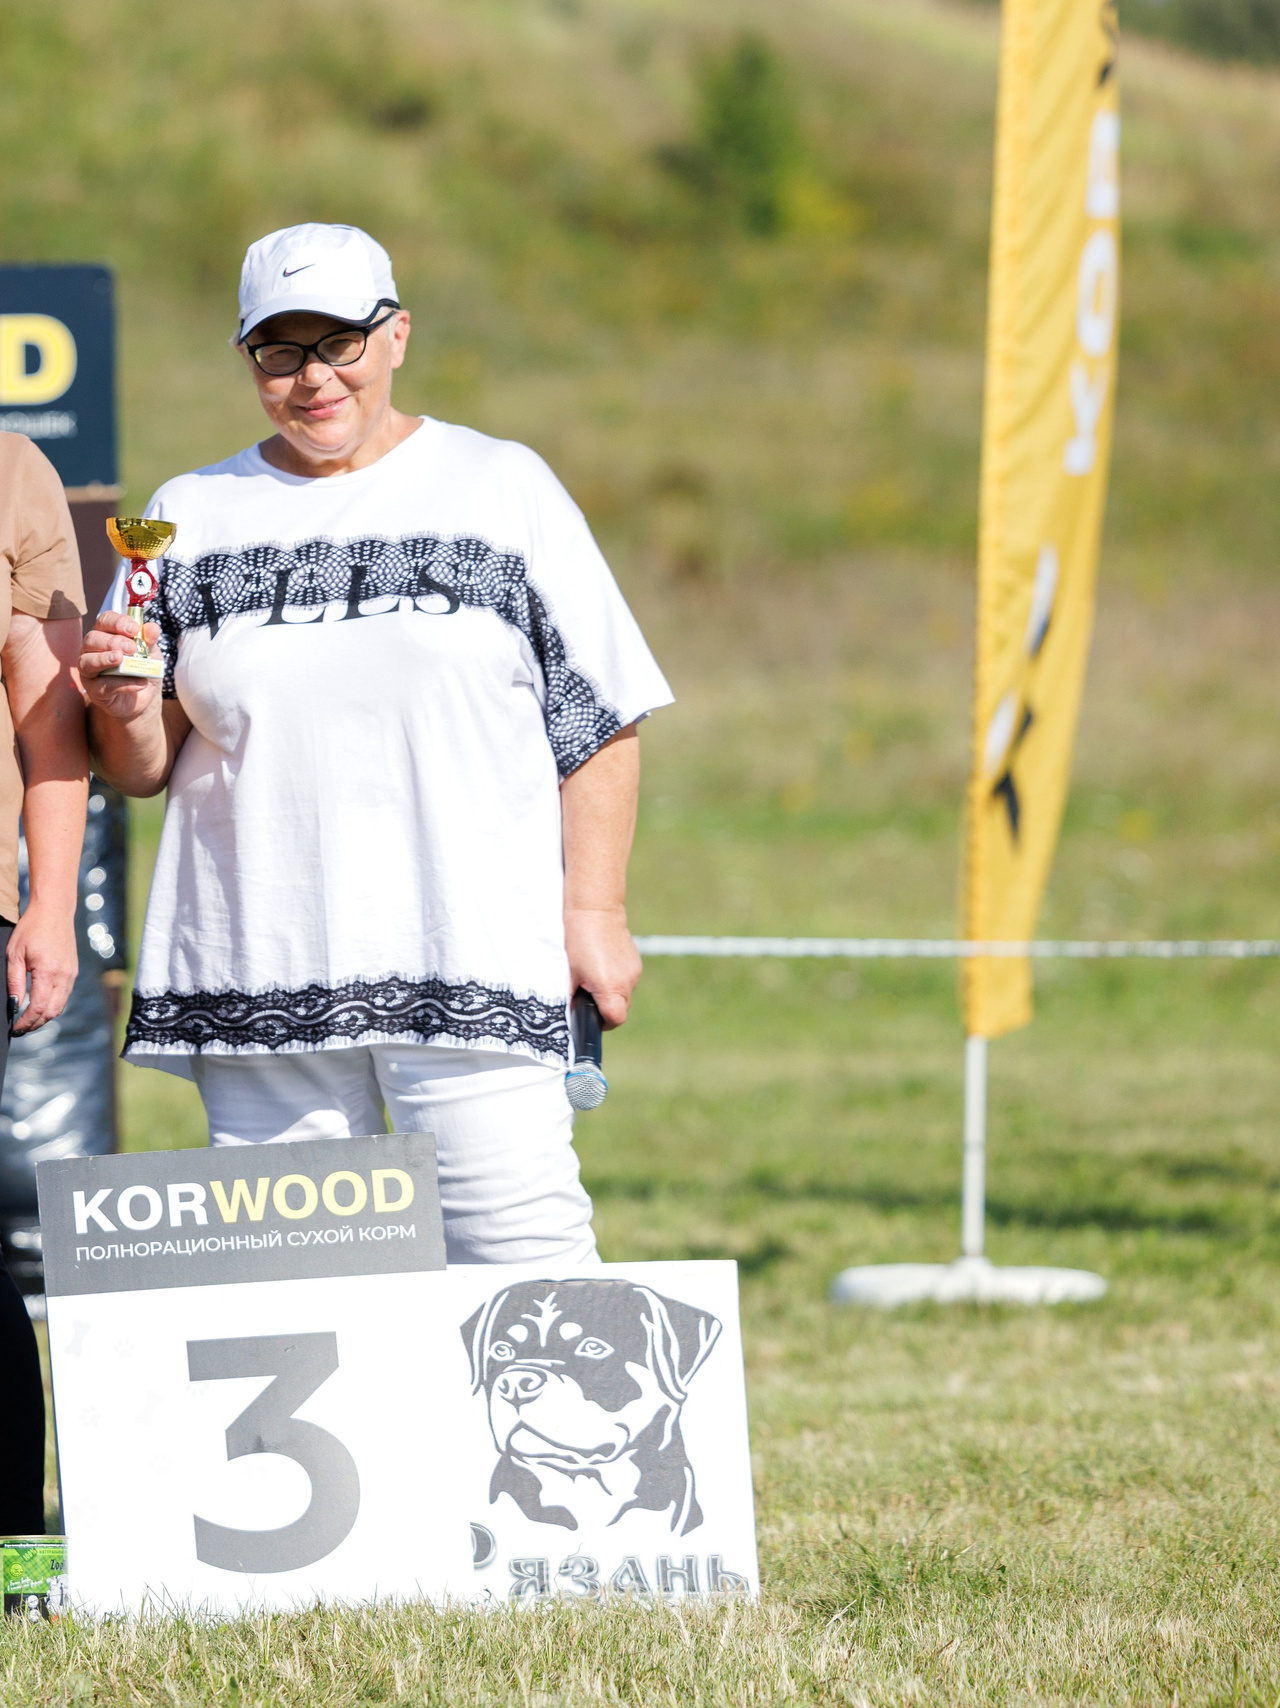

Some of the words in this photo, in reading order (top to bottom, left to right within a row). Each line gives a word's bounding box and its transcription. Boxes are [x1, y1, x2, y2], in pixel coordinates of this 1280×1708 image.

[73, 1168, 415, 1234] KORWOOD
[76, 1230, 282, 1262] ПОЛНОРАЦИОННЫЙ
[287, 1225, 354, 1246] СУХОЙ
[359, 1223, 416, 1242] КОРМ
[186, 1331, 361, 1575] 3
